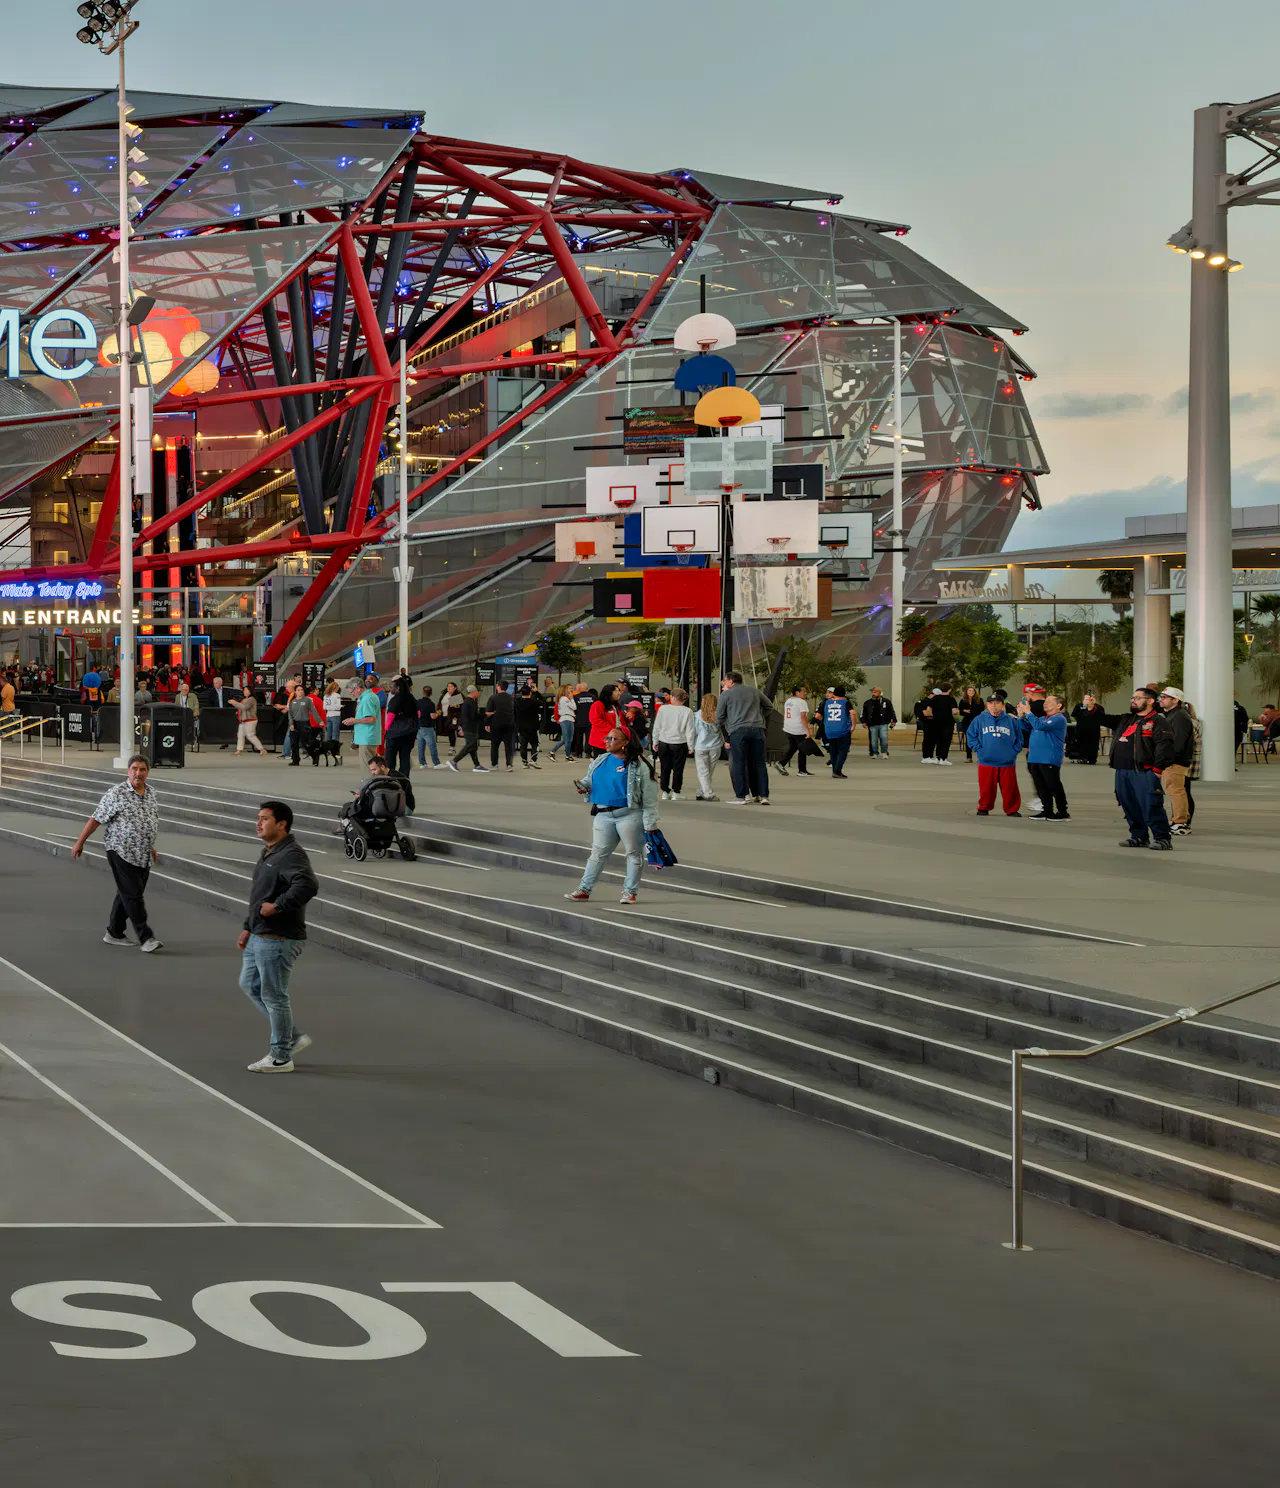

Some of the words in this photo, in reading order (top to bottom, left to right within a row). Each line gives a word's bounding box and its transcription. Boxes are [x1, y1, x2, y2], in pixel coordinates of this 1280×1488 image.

[0, 582, 34, 598] Make
[38, 582, 74, 599] Today
[76, 582, 102, 599] Epic
[827, 709, 842, 721] 32
[10, 1280, 642, 1360] LOS
